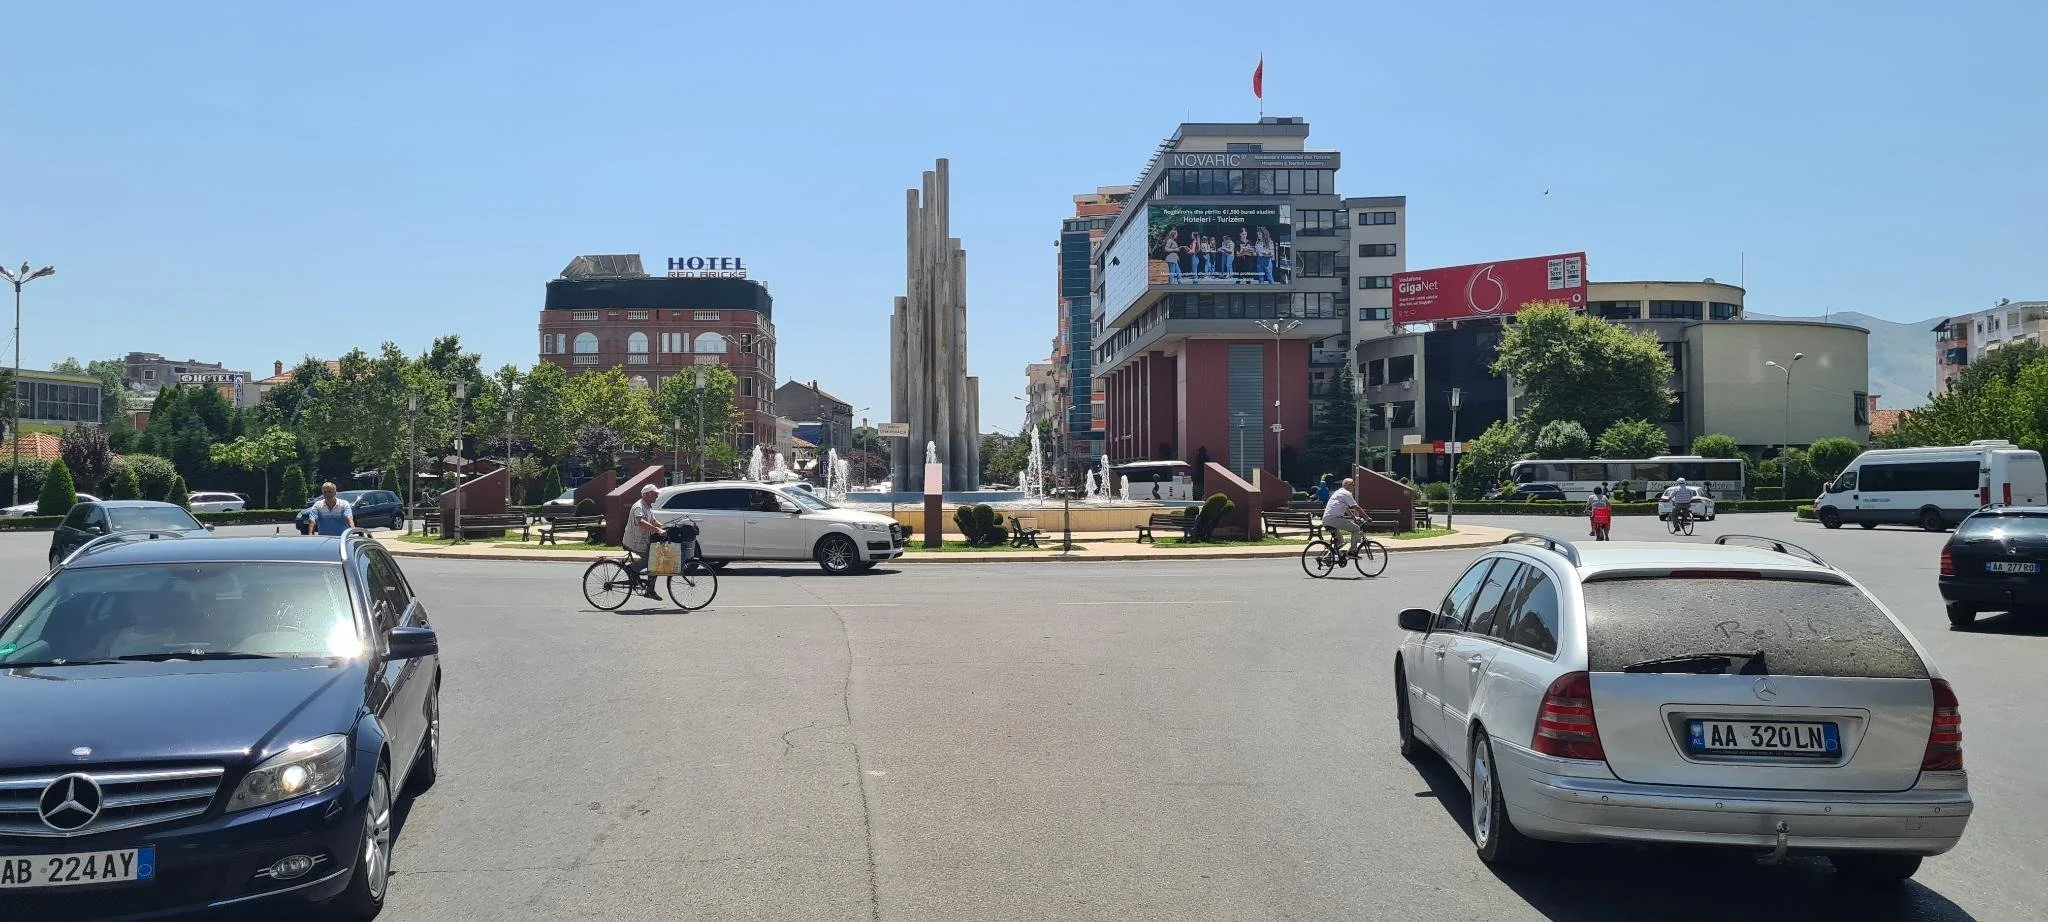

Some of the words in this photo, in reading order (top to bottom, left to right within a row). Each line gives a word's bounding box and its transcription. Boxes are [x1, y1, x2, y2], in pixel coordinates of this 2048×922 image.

[1174, 154, 1241, 166] NOVARIC
[668, 256, 746, 270] HOTEL
[700, 271, 746, 279] BRICKS
[1399, 280, 1438, 294] GigaNet
[1992, 562, 2003, 571] AA
[1711, 724, 1738, 747] AA
[1, 859, 32, 884] AB
